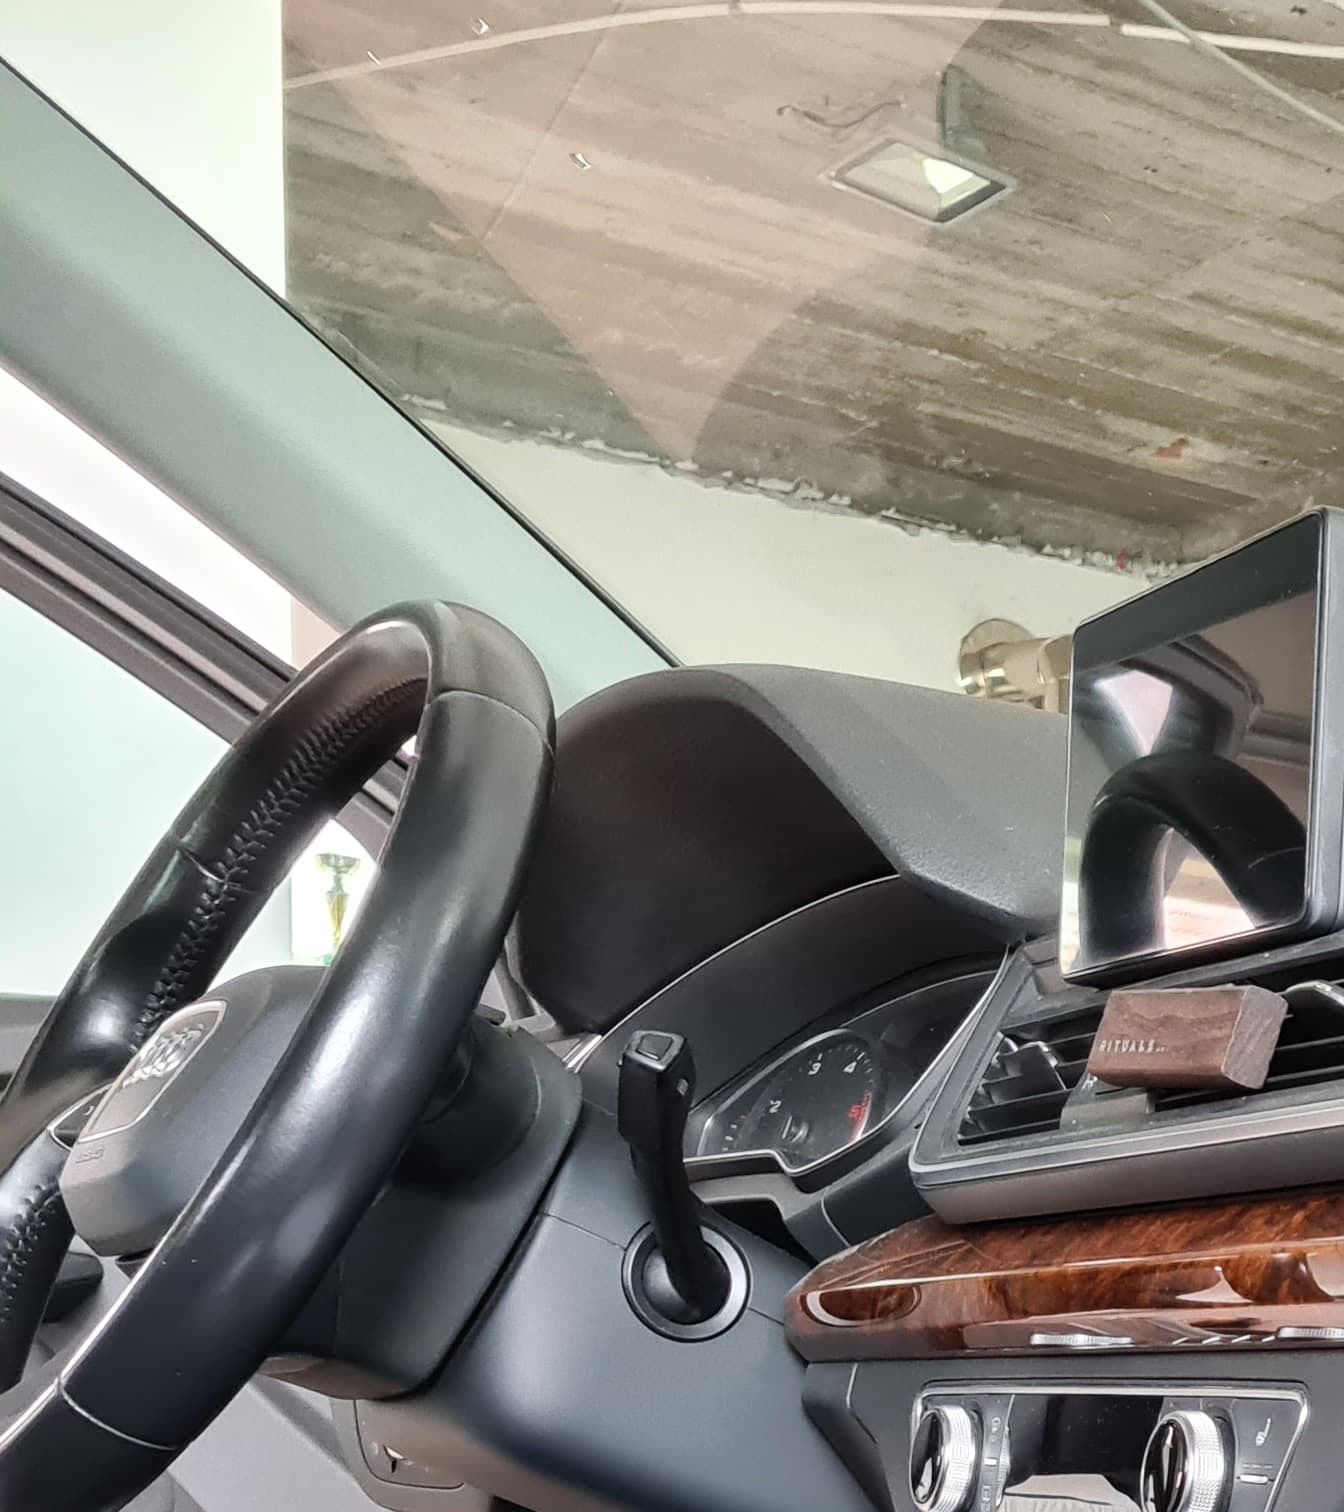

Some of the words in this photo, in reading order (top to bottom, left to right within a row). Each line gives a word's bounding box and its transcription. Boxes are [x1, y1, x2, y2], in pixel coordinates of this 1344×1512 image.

[808, 1062, 822, 1075] 3
[843, 1061, 857, 1073] 4
[769, 1099, 782, 1113] 2
